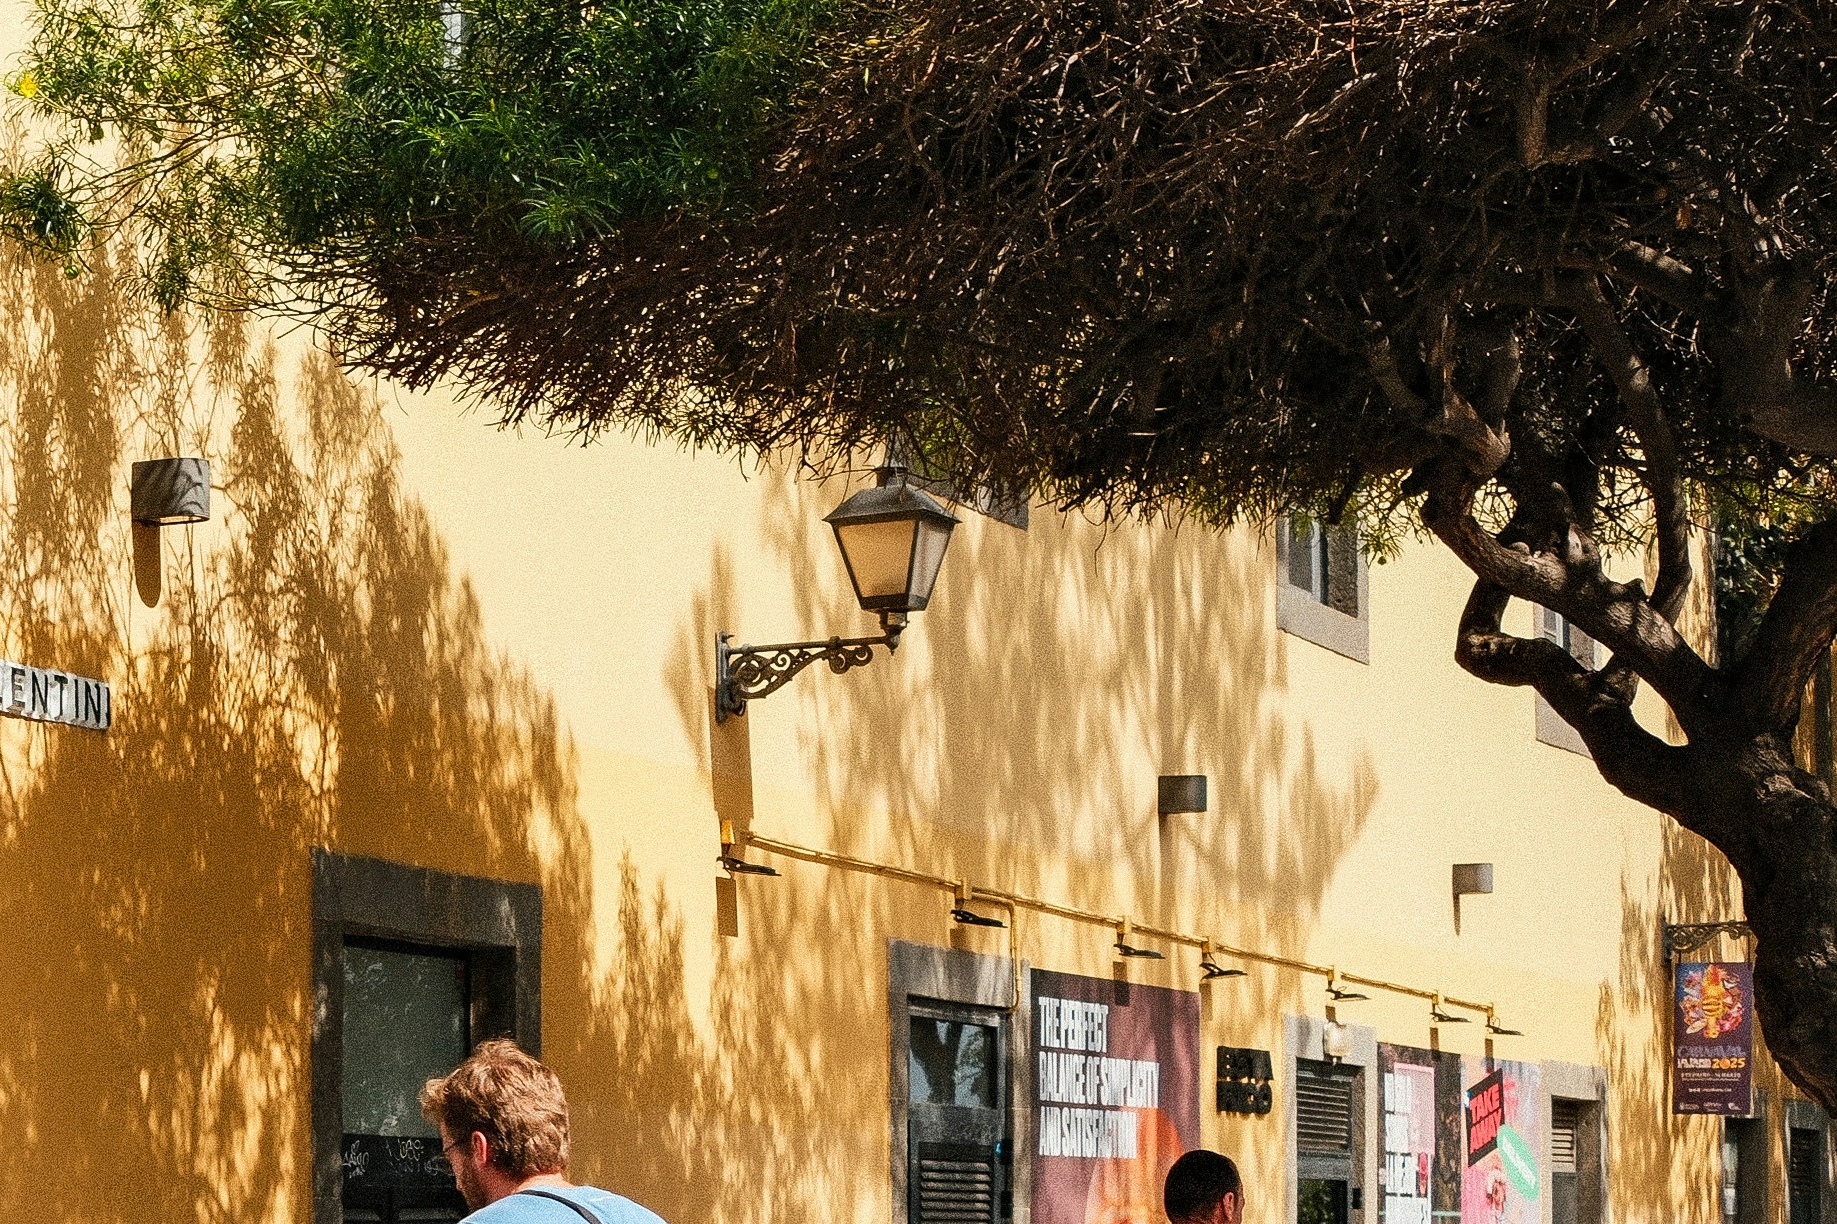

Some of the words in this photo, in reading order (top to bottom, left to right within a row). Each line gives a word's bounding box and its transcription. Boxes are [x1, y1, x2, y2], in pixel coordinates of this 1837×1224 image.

[1038, 996, 1060, 1048] THE
[1060, 999, 1109, 1053] PERFECT
[1038, 1051, 1085, 1104] BALANCE
[1086, 1055, 1100, 1105] OF
[1101, 1056, 1160, 1109] SIMPLICITY
[1711, 1058, 1746, 1069] 2025
[1469, 1083, 1500, 1124] TAKE
[1039, 1106, 1061, 1157] AND
[1061, 1107, 1138, 1159] SATISFACTION
[1469, 1108, 1502, 1155] AWAY
